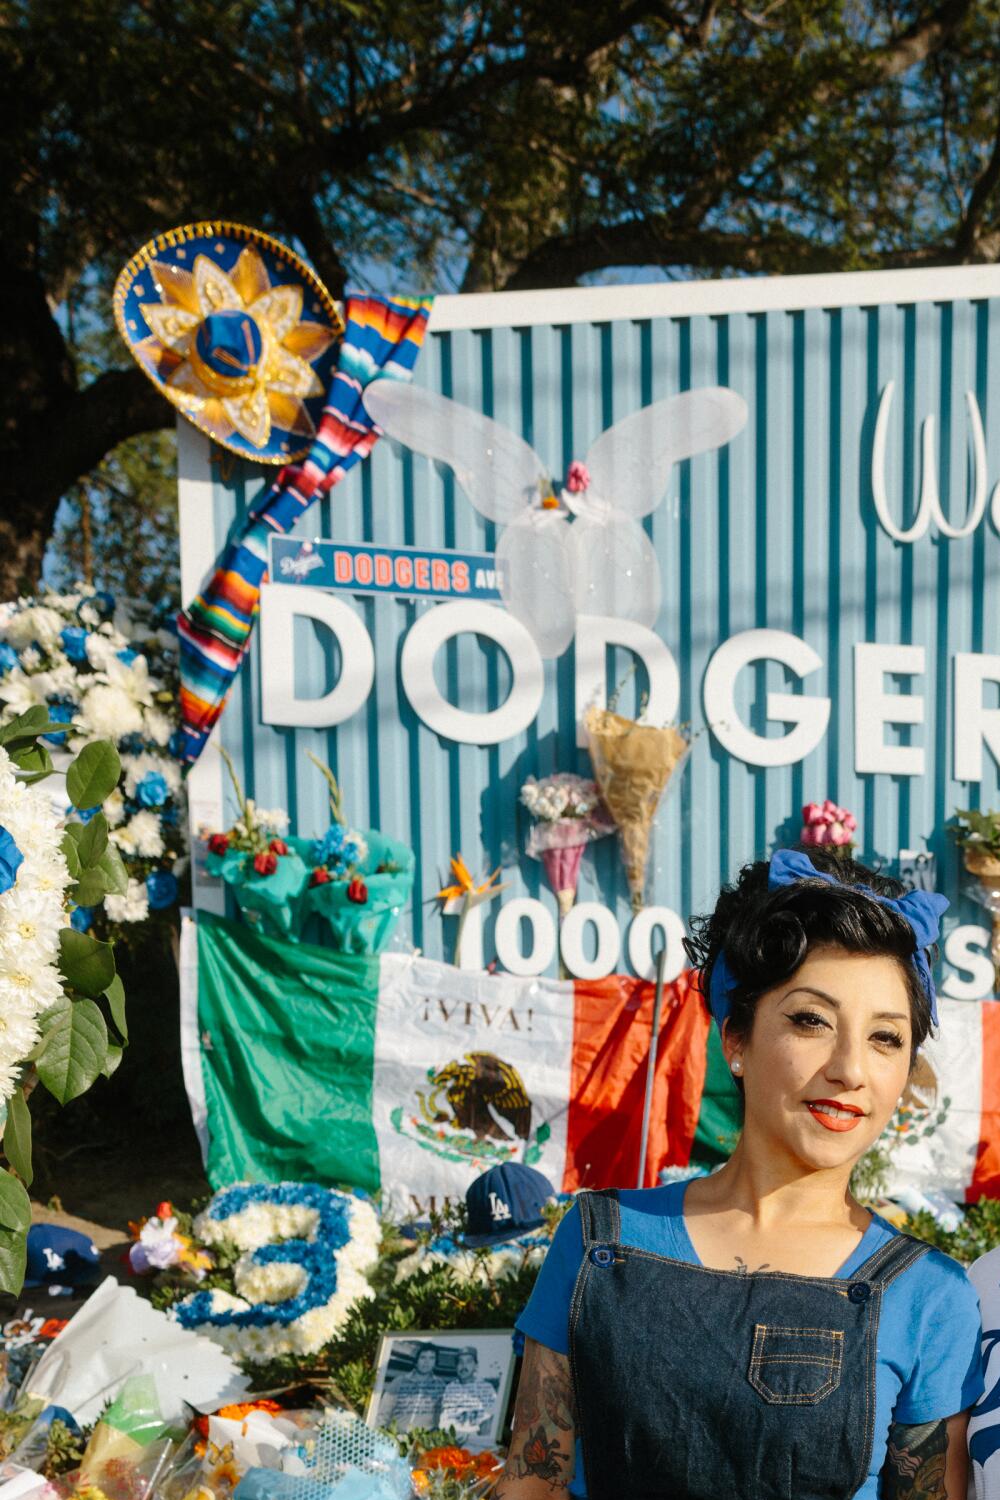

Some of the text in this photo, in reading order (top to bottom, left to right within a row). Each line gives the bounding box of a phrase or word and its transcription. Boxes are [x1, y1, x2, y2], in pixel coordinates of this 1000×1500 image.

[334, 551, 470, 593] DODGERS
[442, 898, 687, 984] 1000
[423, 998, 534, 1032] ¡VIVA!
[488, 1192, 512, 1221] LA
